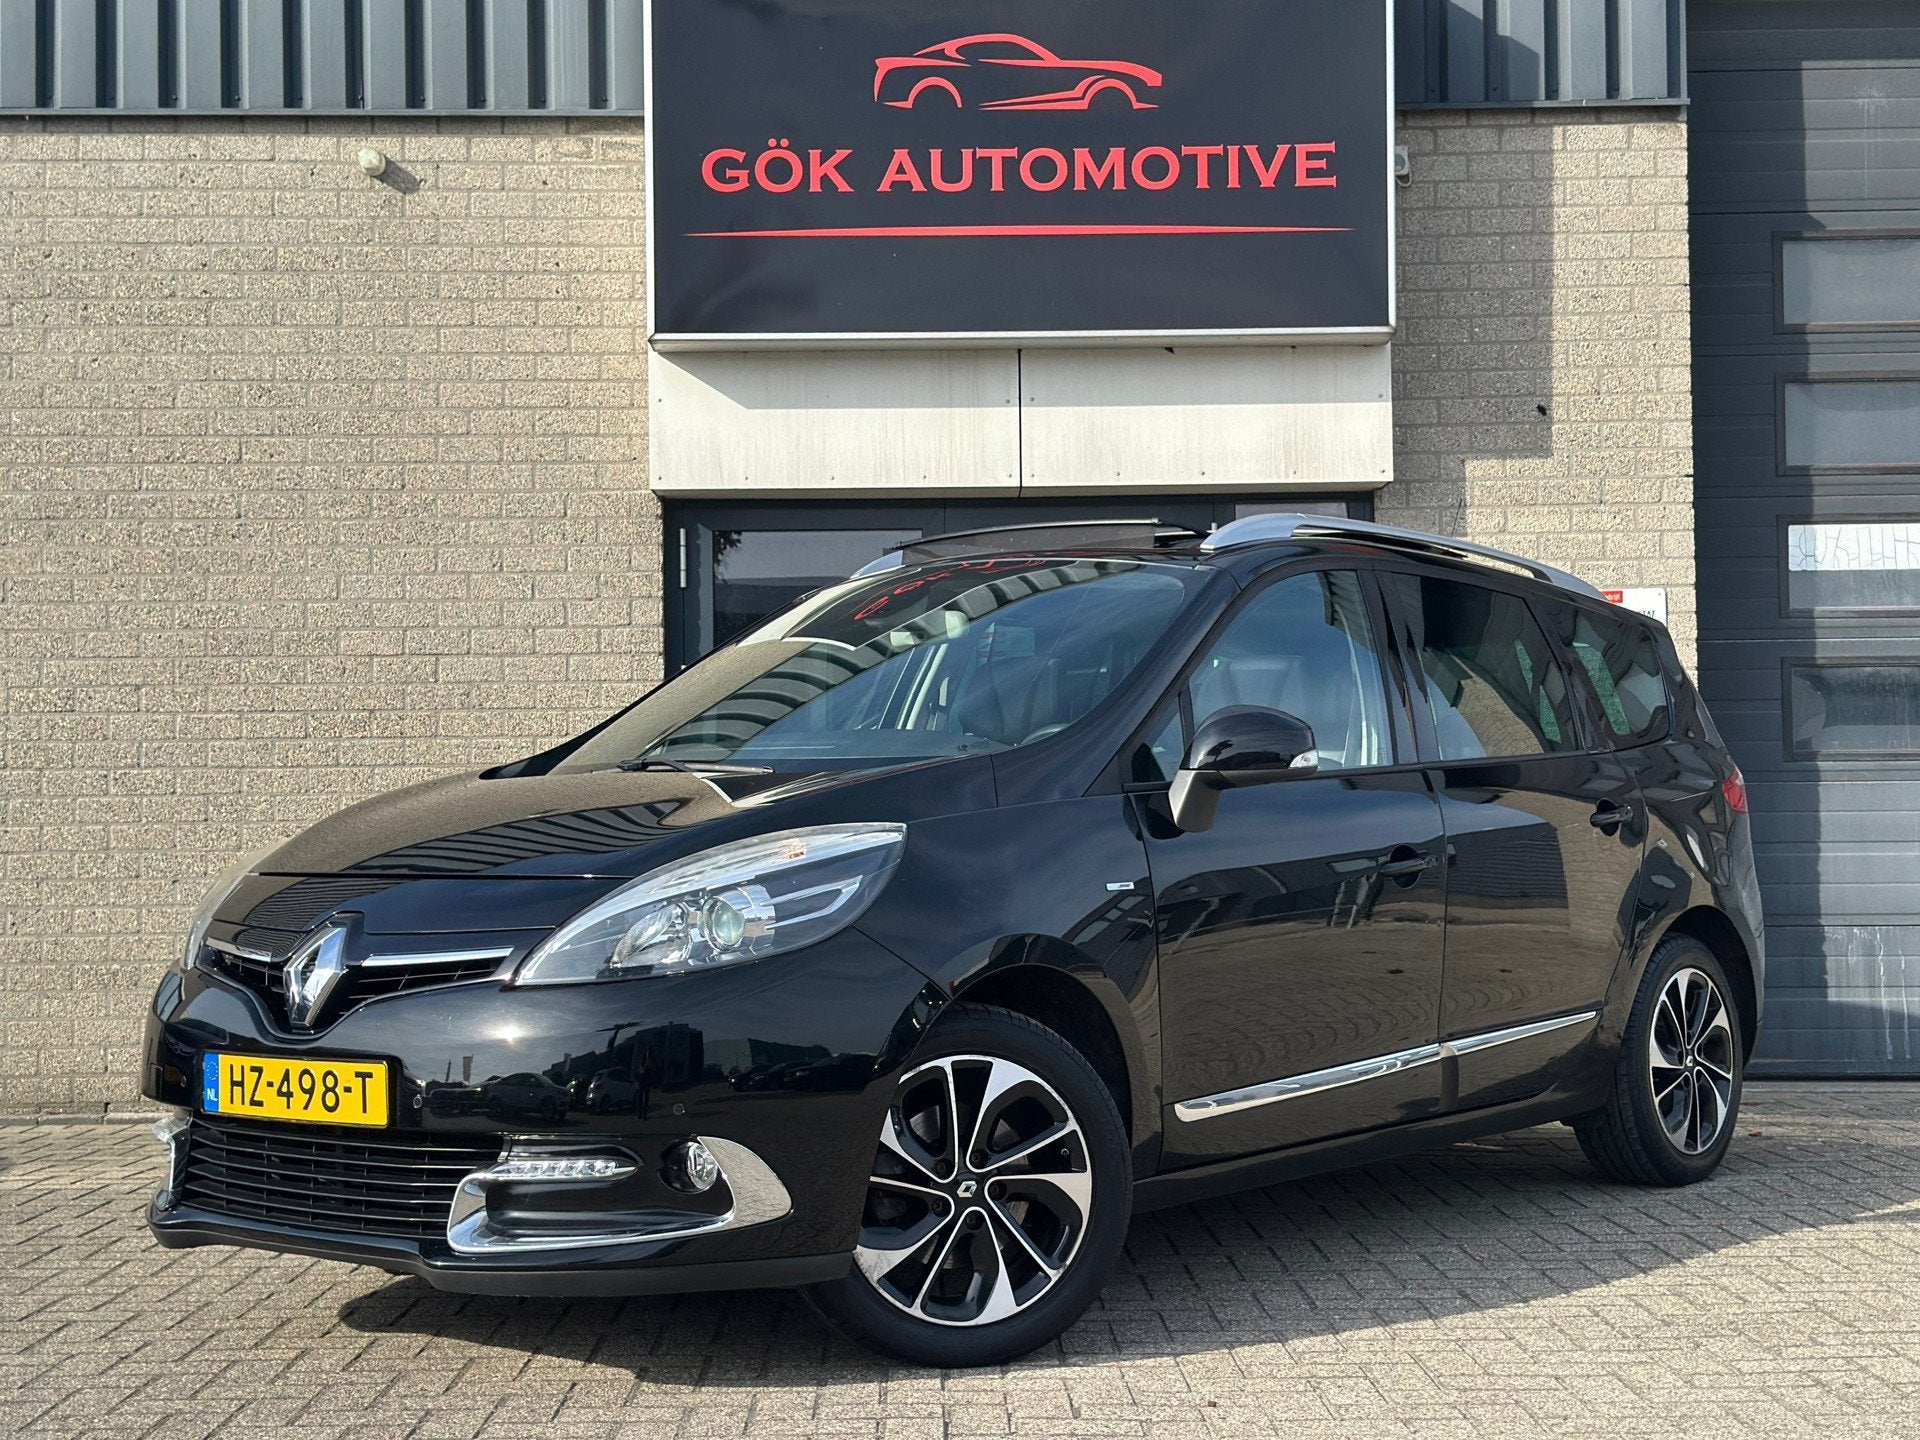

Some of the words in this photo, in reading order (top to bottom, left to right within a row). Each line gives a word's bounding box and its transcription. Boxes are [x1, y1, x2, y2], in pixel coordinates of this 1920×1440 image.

[701, 138, 854, 194] GÖK
[877, 141, 1338, 193] AUTOMOTIVE
[206, 1087, 218, 1102] NL
[229, 1063, 374, 1114] HZ-498-T
